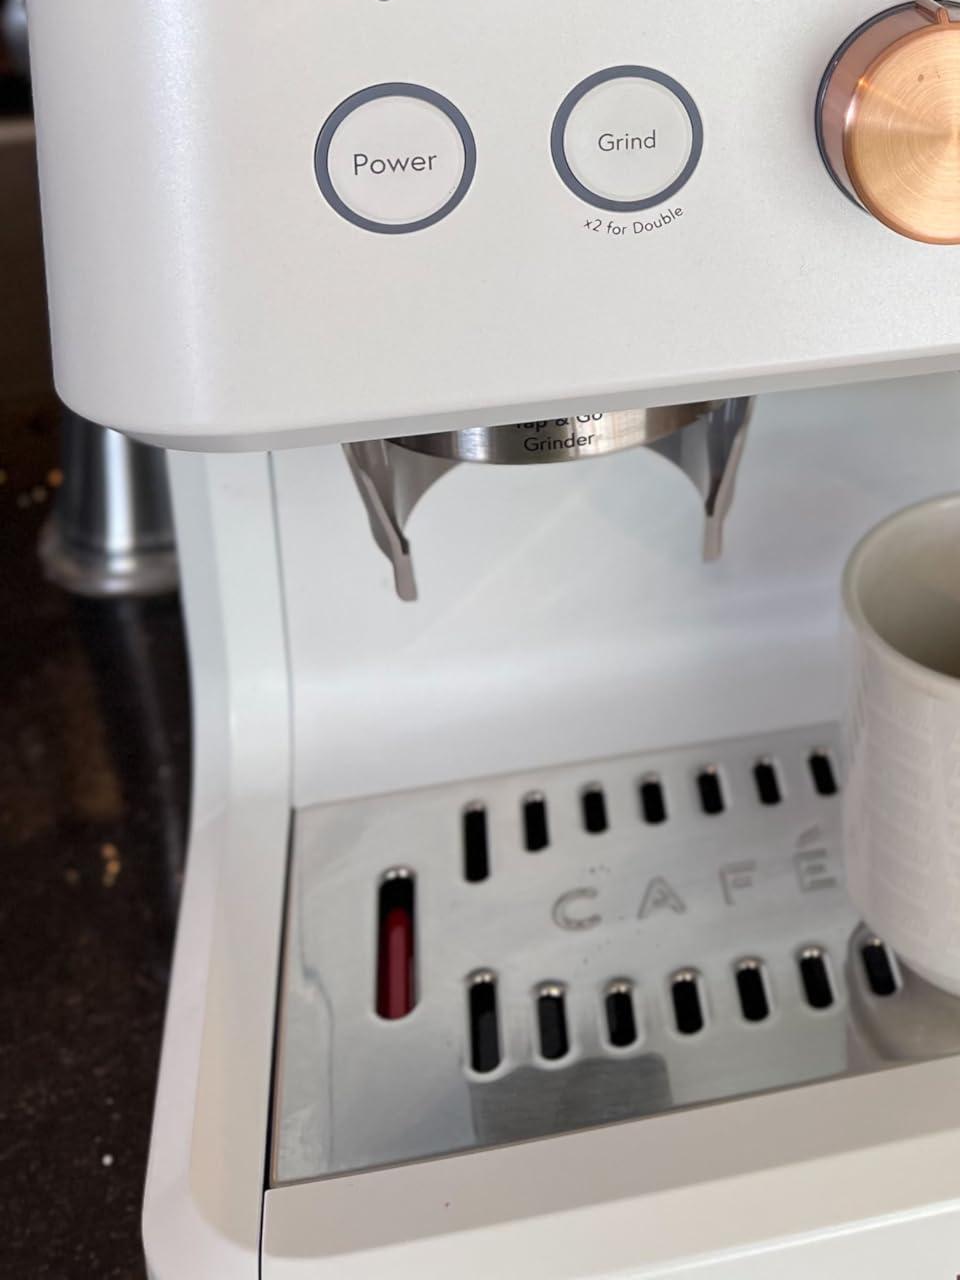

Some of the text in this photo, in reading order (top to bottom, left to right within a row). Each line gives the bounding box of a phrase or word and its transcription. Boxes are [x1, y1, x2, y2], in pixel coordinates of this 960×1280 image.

[597, 129, 657, 152] Grind
[353, 152, 438, 175] Power
[607, 221, 627, 235] for
[632, 207, 684, 234] Double
[523, 433, 595, 452] Grinder
[552, 824, 838, 932] CAFÉ
